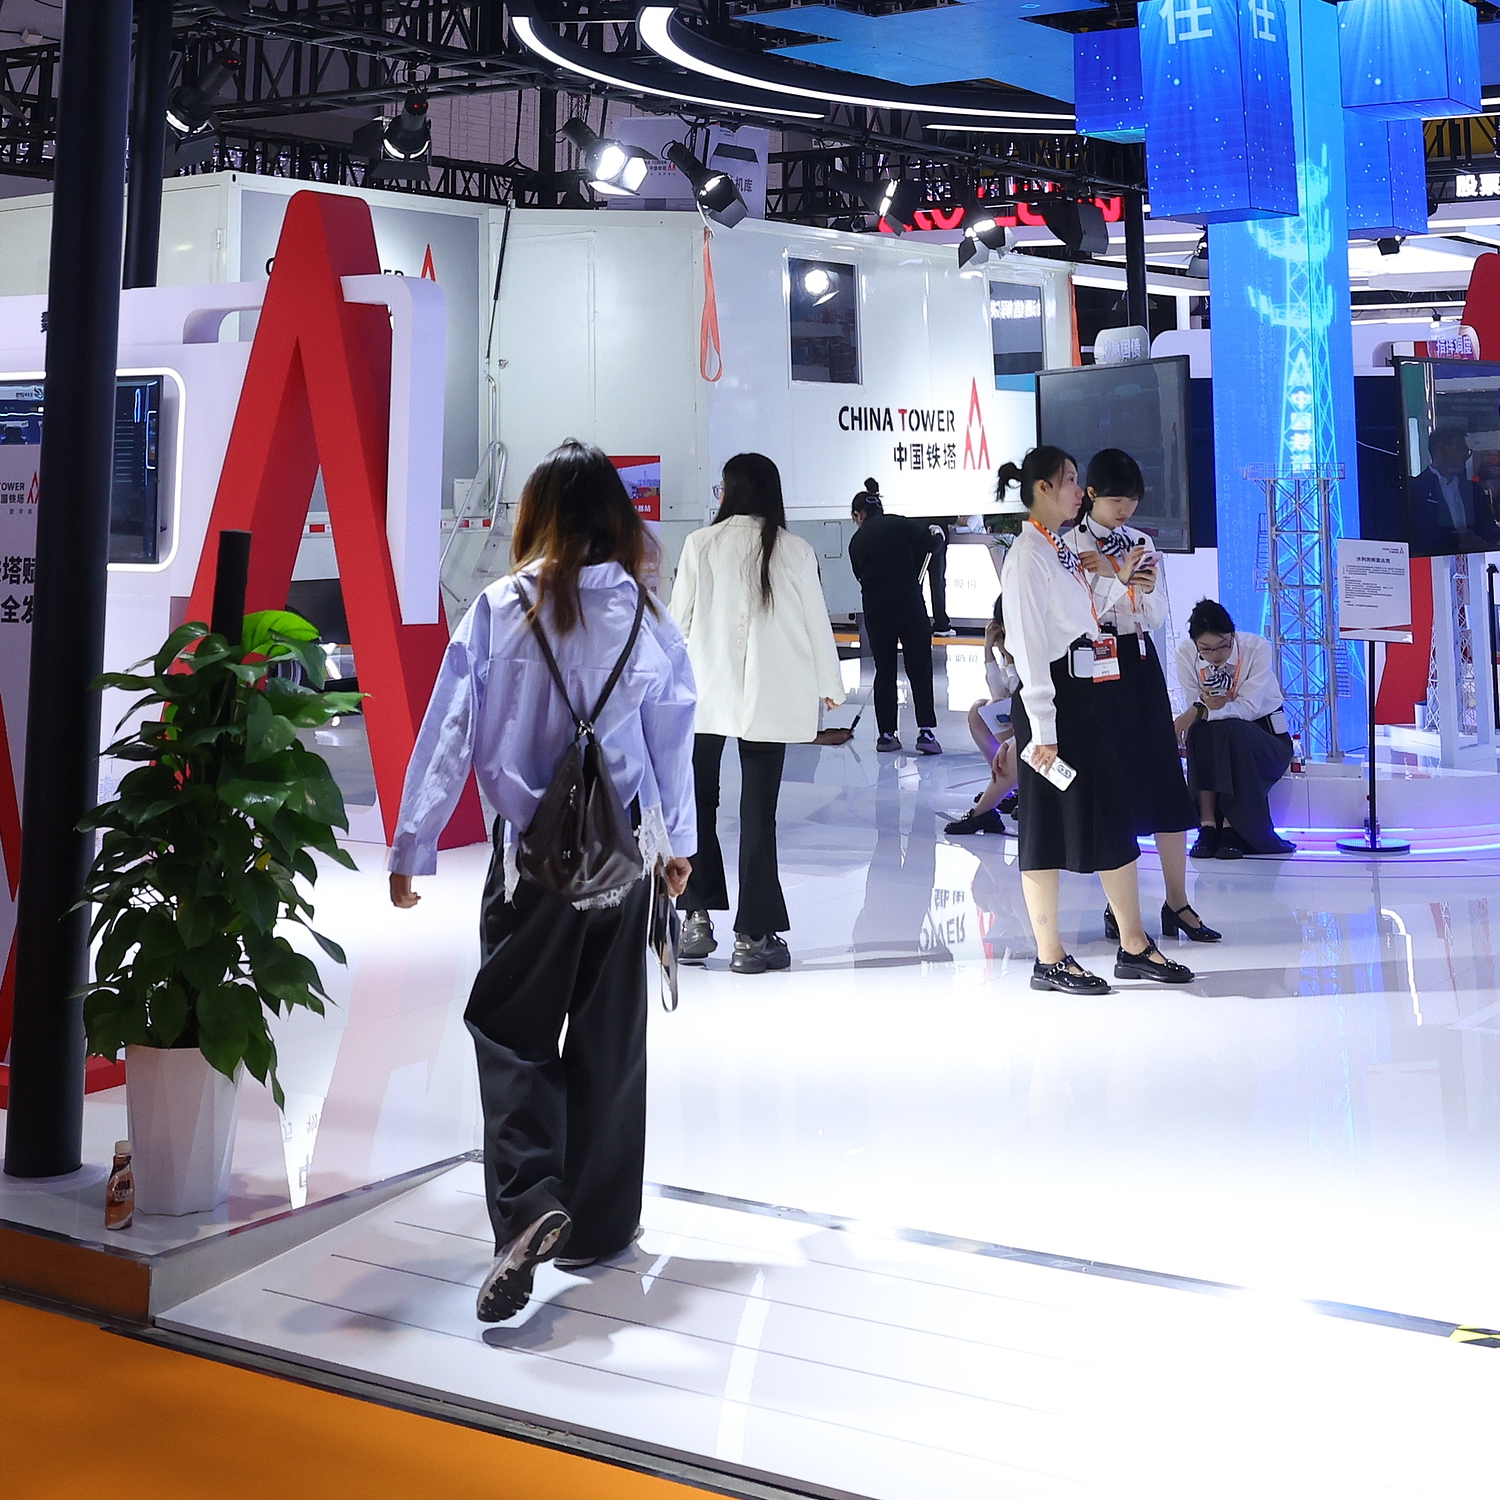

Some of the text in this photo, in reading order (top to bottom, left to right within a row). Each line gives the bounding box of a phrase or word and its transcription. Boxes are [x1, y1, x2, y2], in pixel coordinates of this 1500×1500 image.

[838, 406, 955, 432] CHINA TOWER
[893, 442, 956, 470] 中国铁塔
